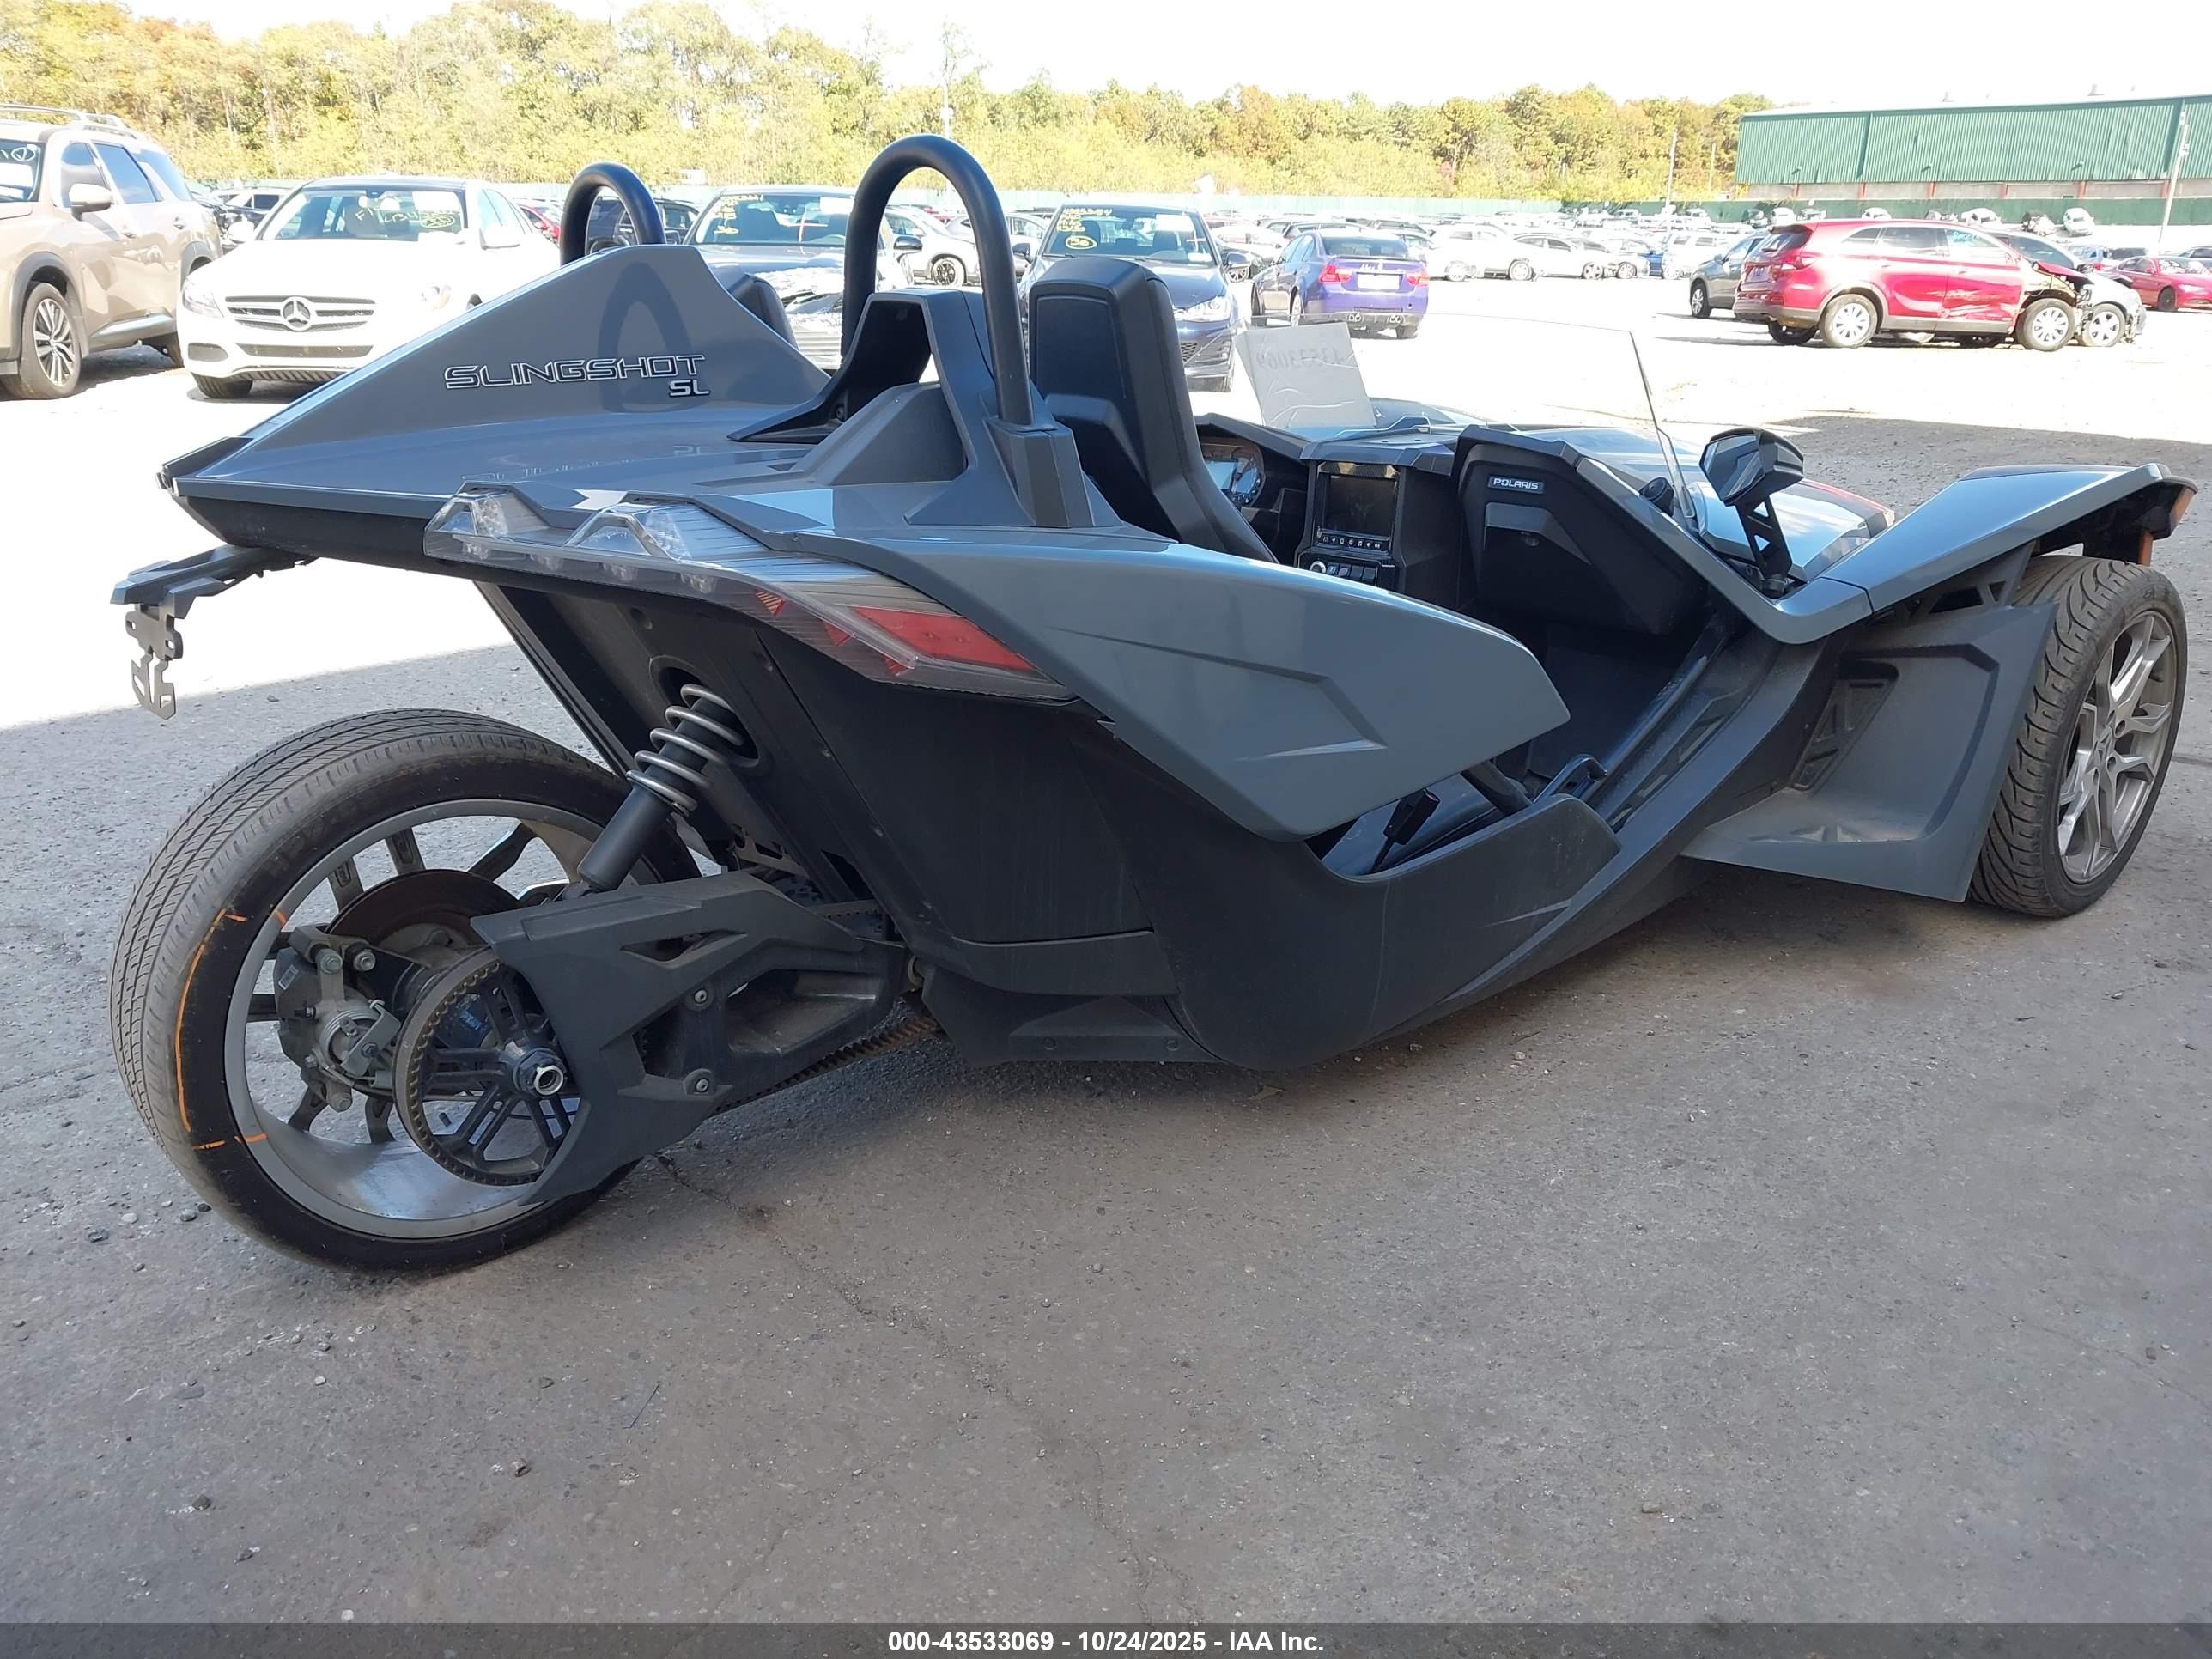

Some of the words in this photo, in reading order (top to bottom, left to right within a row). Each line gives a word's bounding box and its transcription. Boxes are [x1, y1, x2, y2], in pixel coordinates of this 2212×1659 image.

[444, 354, 706, 389] SLINGSHOT
[669, 379, 710, 397] SL
[1493, 477, 1539, 489] POLARIS
